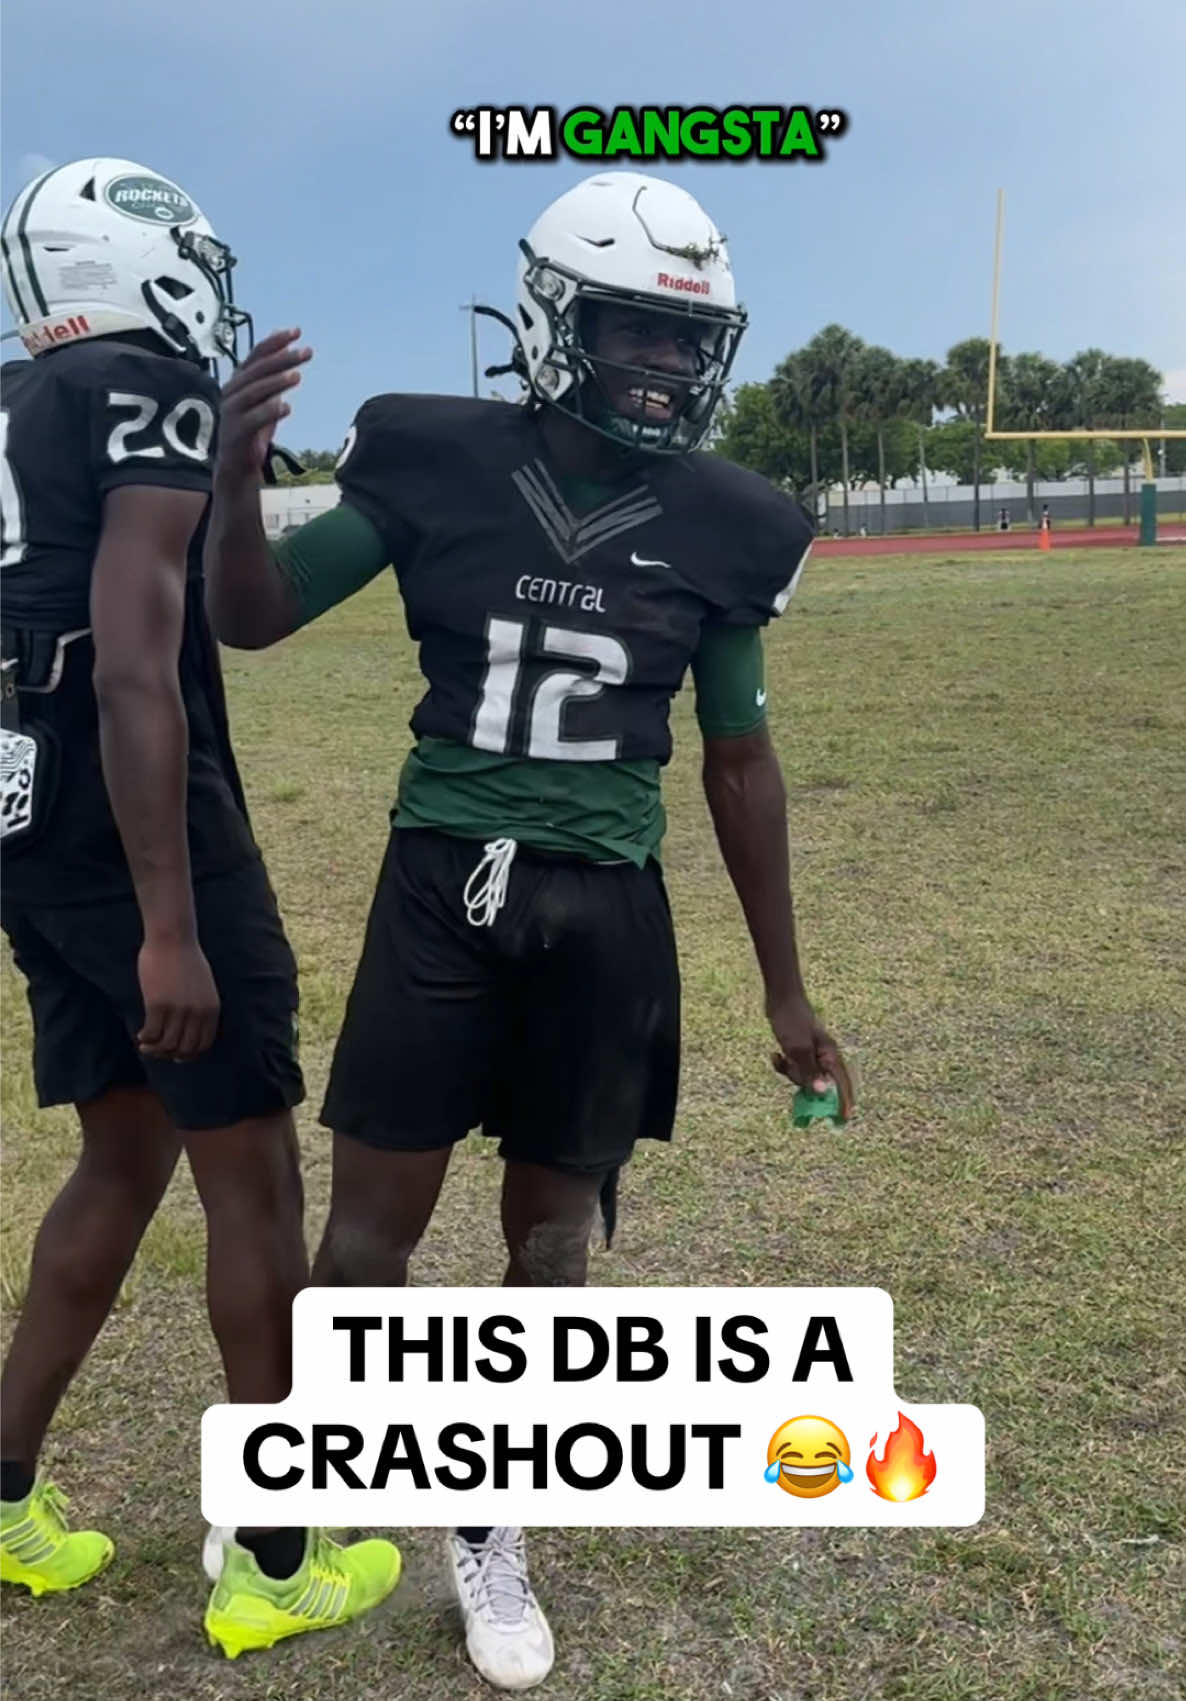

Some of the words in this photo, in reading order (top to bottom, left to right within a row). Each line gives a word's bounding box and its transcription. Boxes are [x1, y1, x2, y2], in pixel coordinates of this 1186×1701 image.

[115, 189, 188, 207] ROCKETS
[657, 272, 711, 295] Riddell
[107, 392, 214, 464] 20
[471, 608, 629, 762] 12
